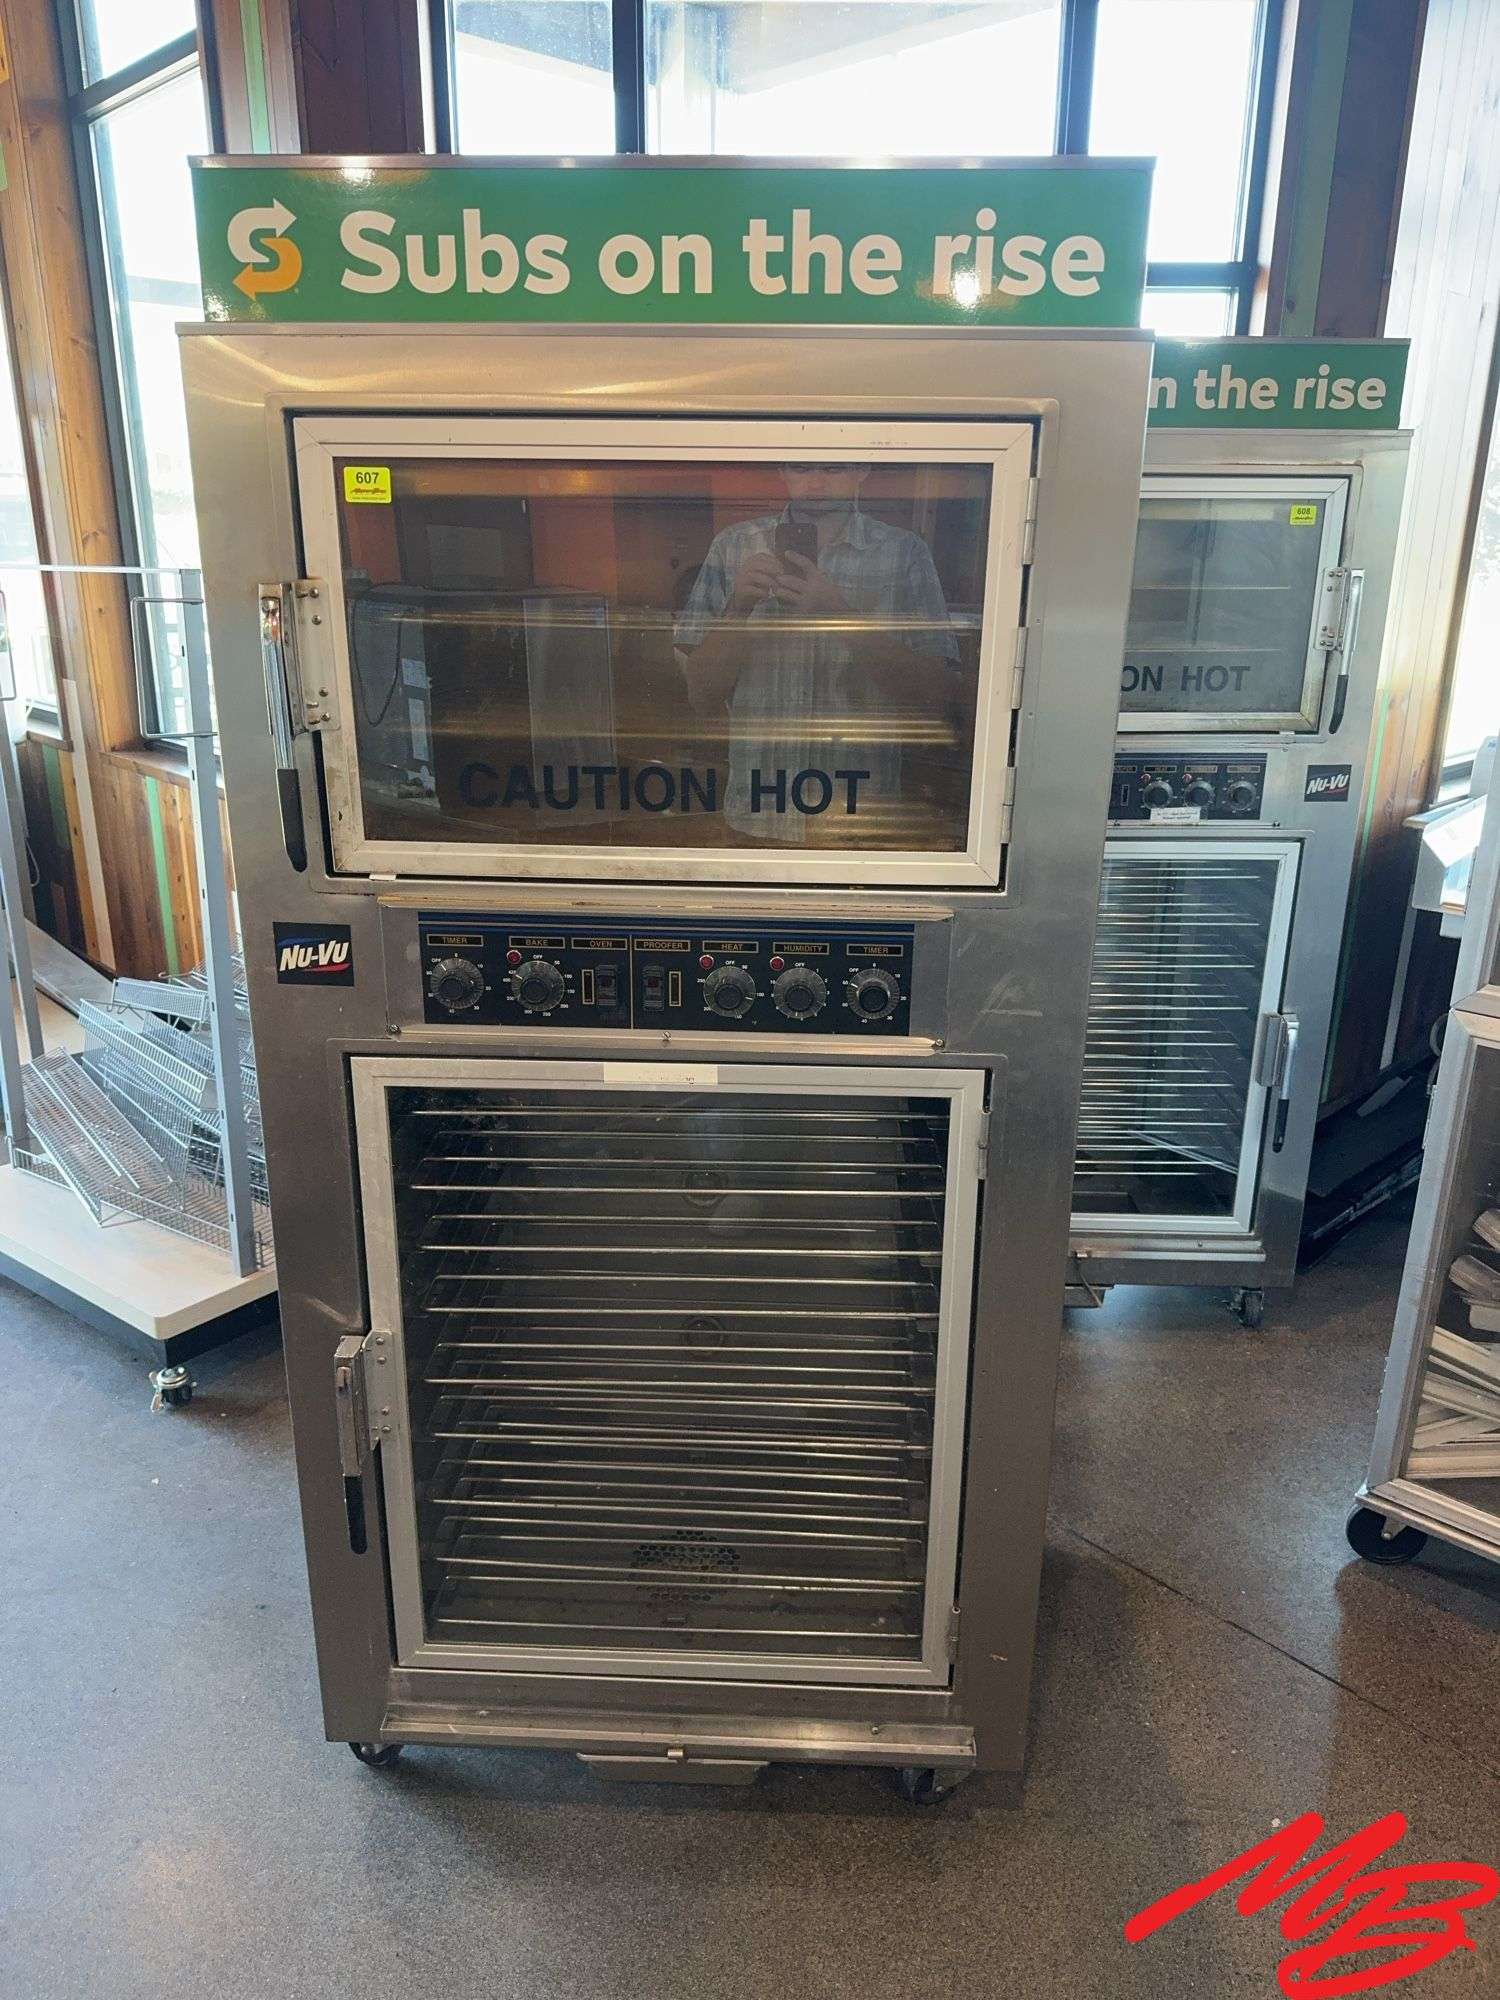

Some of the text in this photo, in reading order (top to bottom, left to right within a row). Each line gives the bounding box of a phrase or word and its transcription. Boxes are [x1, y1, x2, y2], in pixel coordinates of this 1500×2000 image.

[340, 207, 1106, 297] Subs on the rise
[1193, 364, 1279, 410] the
[1293, 364, 1387, 410] rise
[355, 471, 379, 484] 607
[1180, 666, 1250, 691] HOT
[457, 761, 871, 815] CAUTION HOT
[442, 936, 468, 944] TIMER
[589, 940, 613, 948] OVEN
[643, 941, 683, 949] PROOFER
[721, 943, 743, 951] HEAT
[863, 946, 889, 954] TIMER
